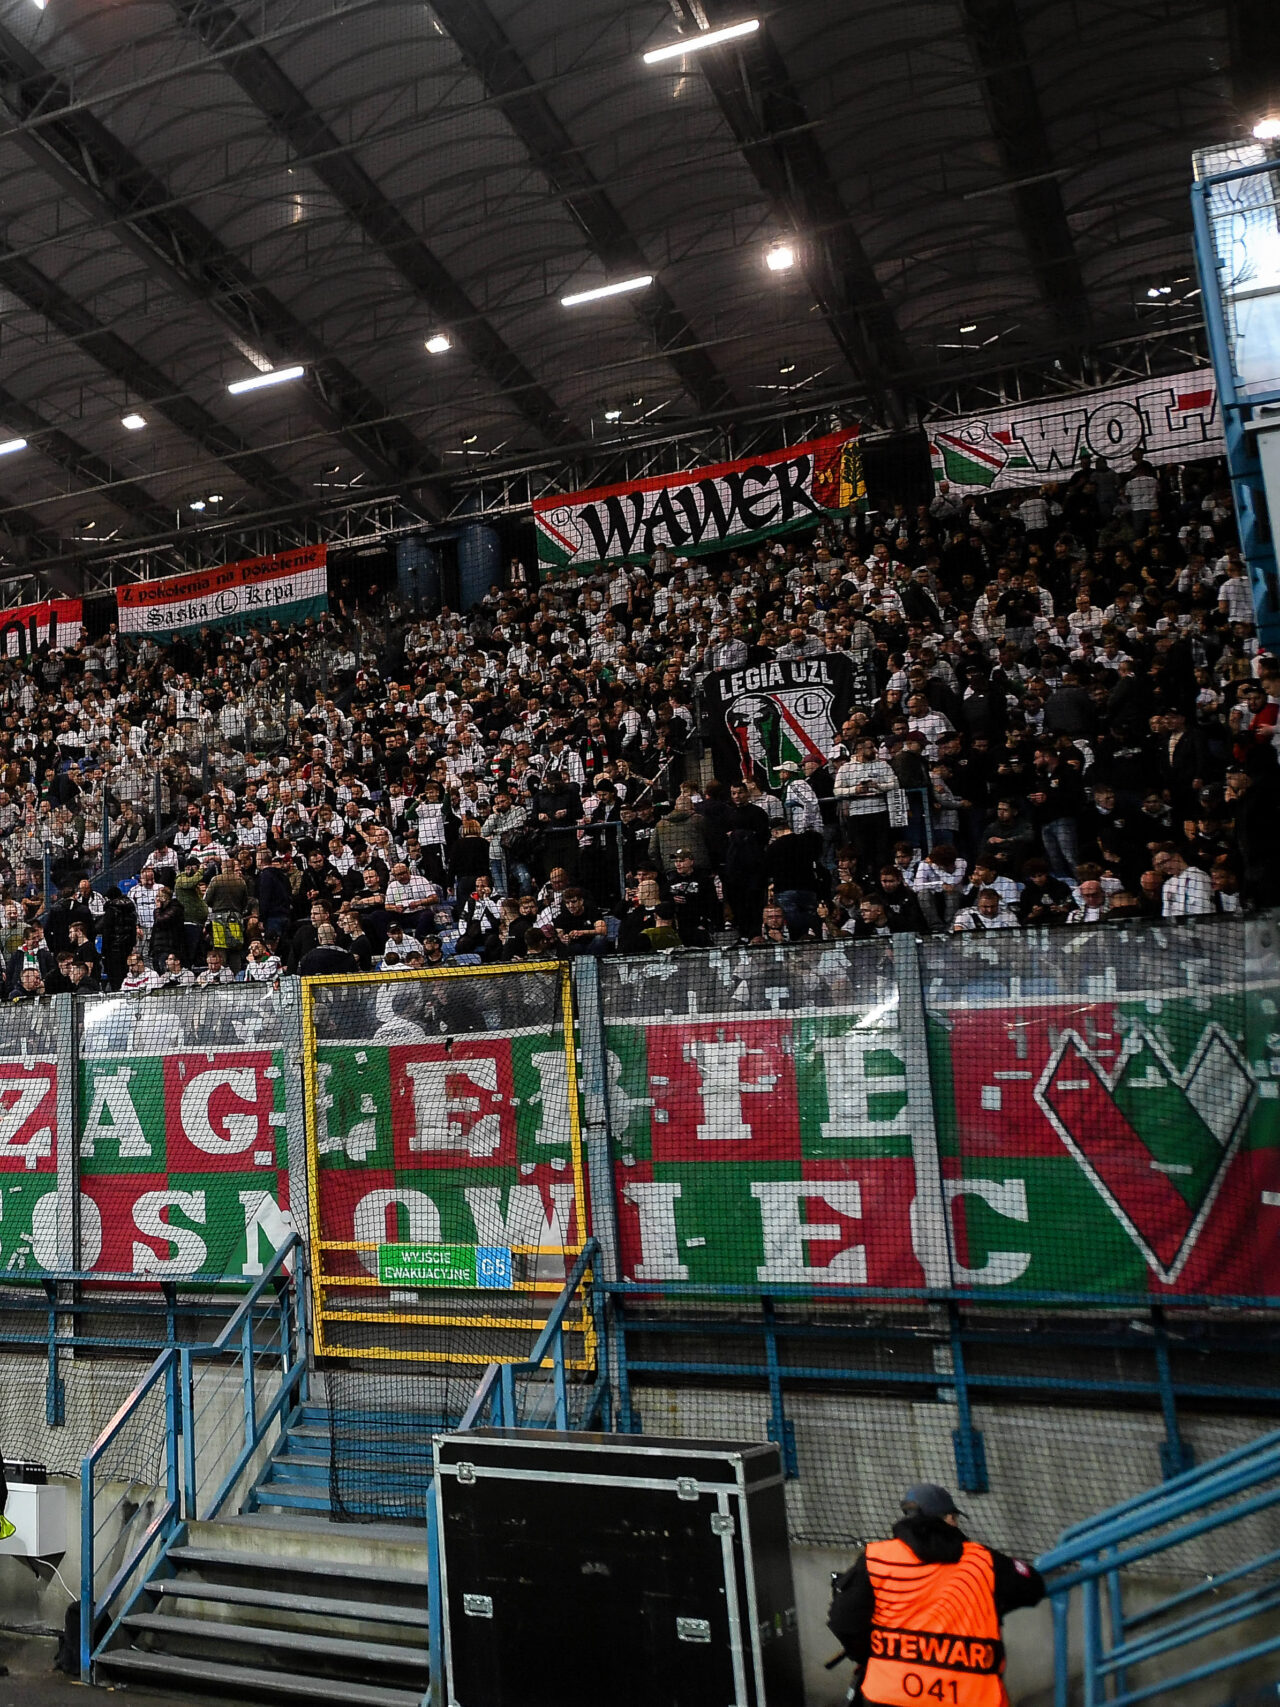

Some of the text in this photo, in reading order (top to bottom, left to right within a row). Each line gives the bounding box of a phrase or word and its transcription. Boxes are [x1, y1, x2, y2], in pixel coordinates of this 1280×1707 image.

[1011, 387, 1223, 473] WOL
[121, 587, 134, 602] Z
[216, 571, 235, 586] na
[146, 602, 208, 627] Saska
[719, 662, 785, 701] LEGIA
[790, 661, 834, 686] UZL
[401, 1249, 451, 1265] WYJŚCIE
[481, 1257, 507, 1276] G5
[384, 1266, 471, 1281] EWAKUACYJNE
[902, 1672, 959, 1705] 041
